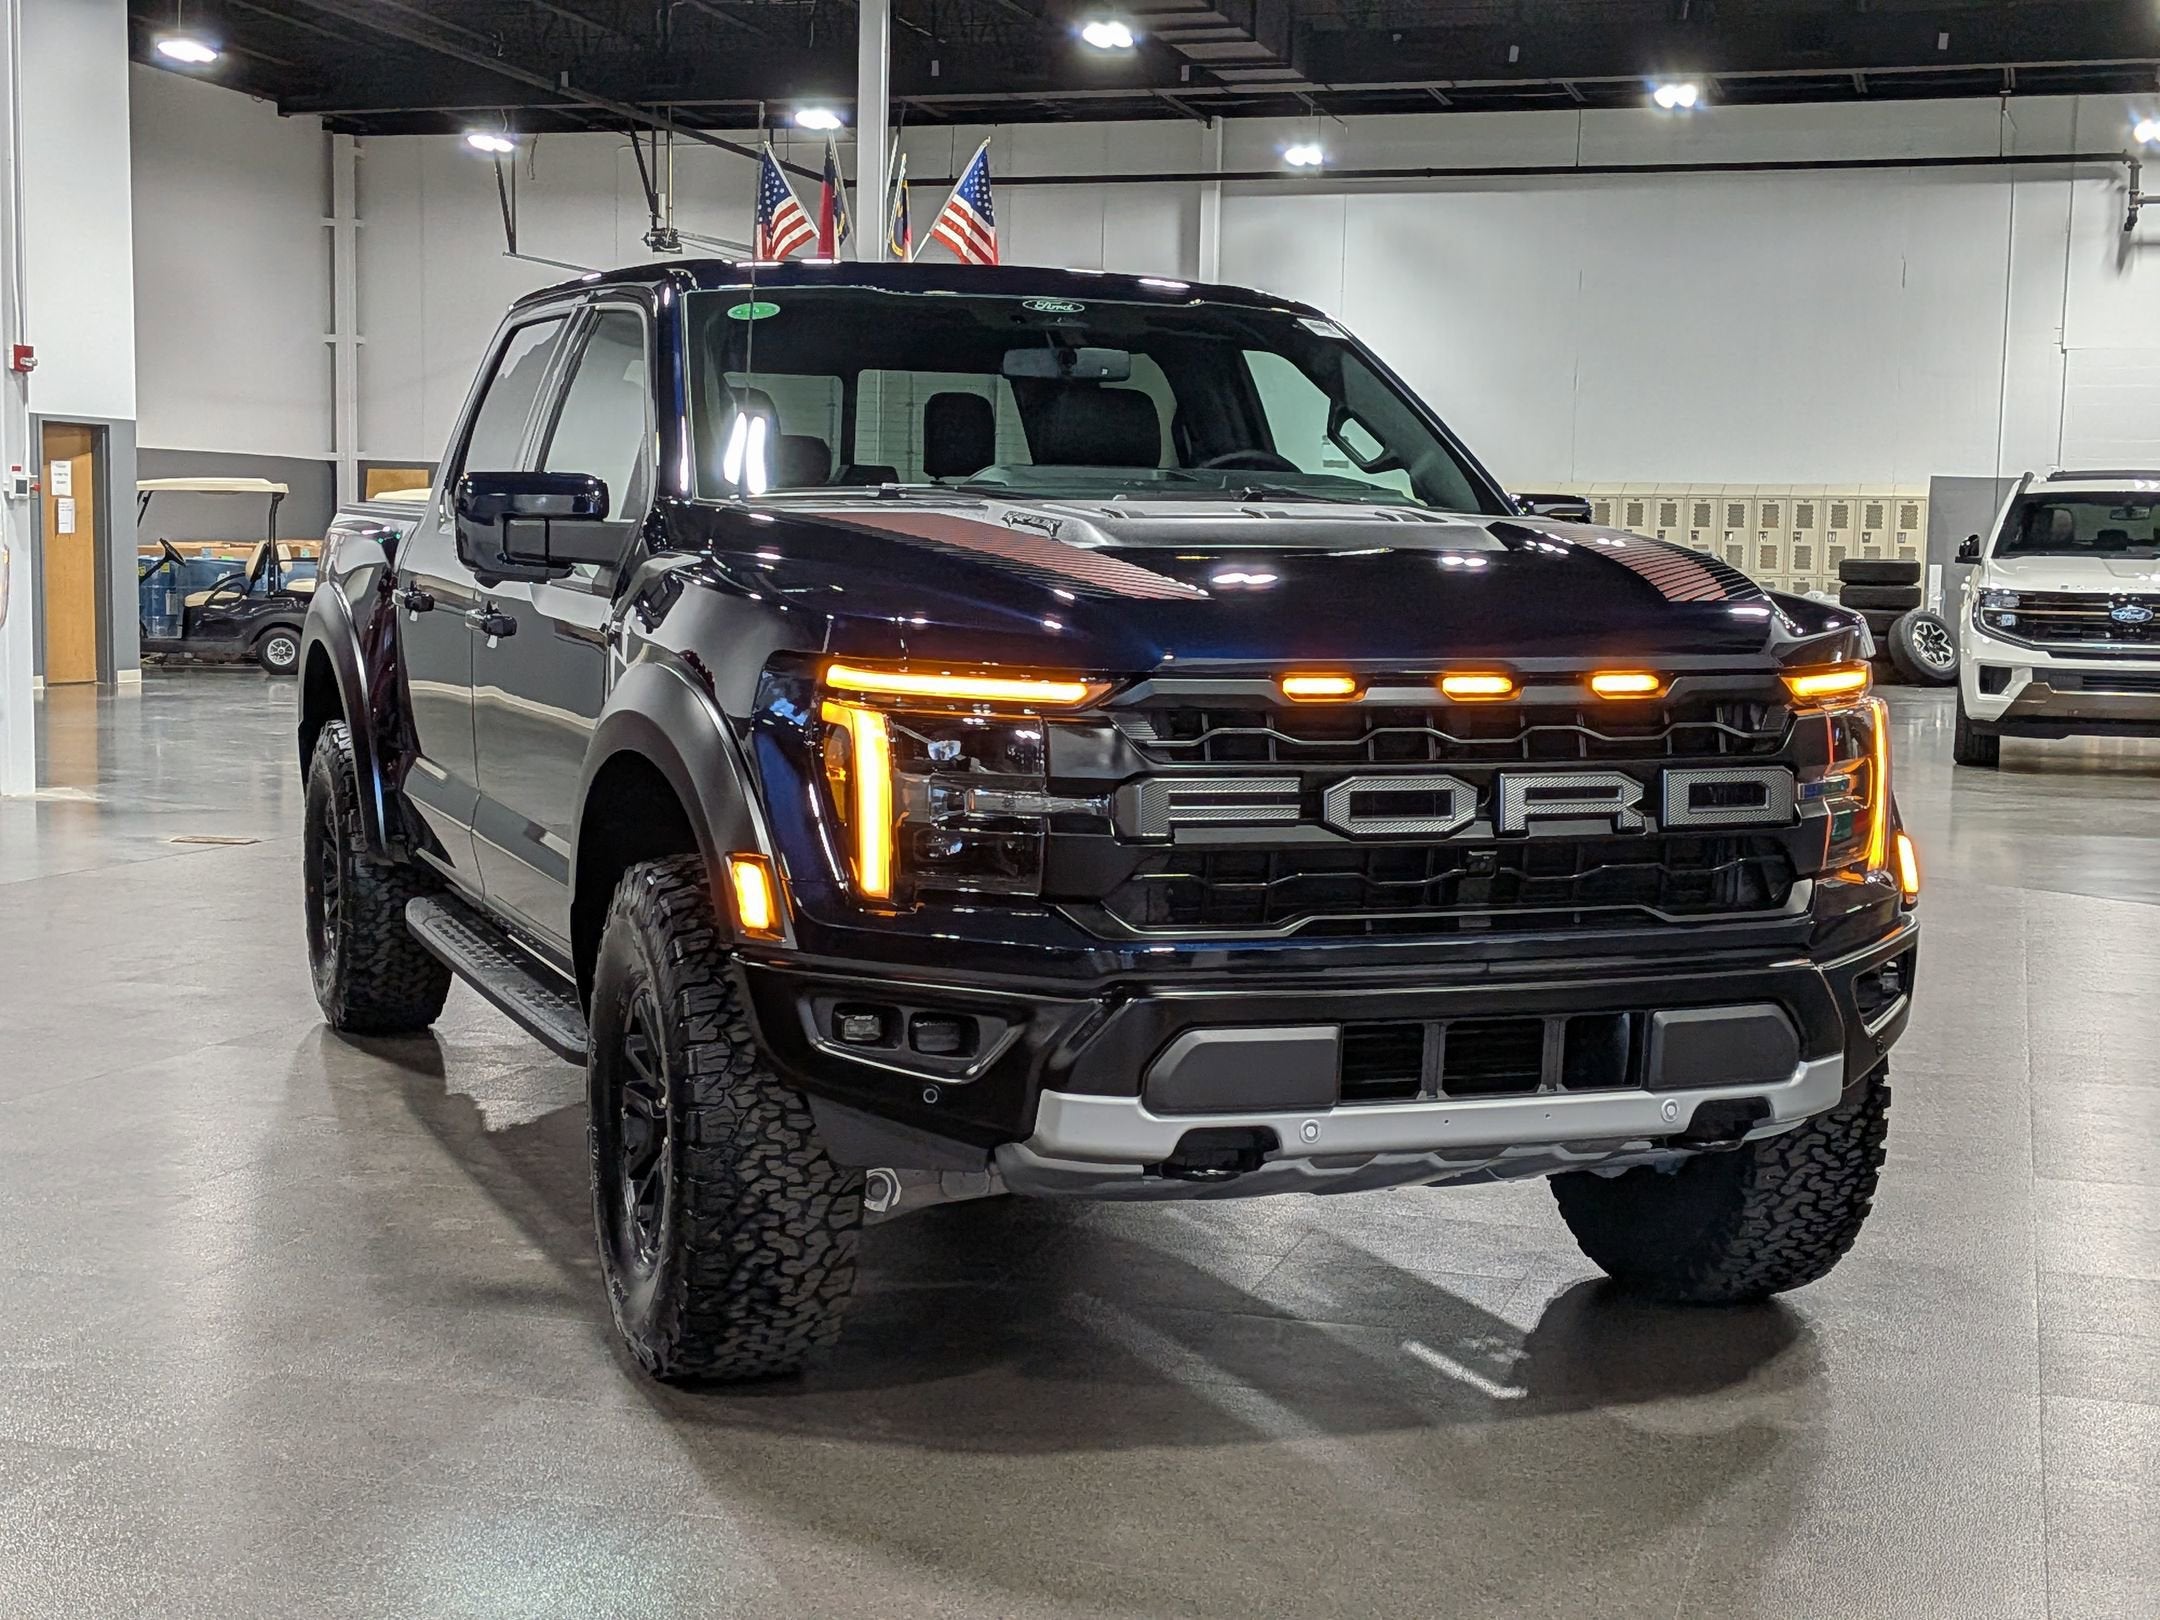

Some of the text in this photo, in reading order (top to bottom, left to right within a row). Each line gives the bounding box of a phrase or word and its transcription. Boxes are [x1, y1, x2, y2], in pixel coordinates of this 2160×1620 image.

[1034, 300, 1075, 312] Ford
[2117, 608, 2147, 621] Ford
[1114, 765, 1795, 845] FORD
